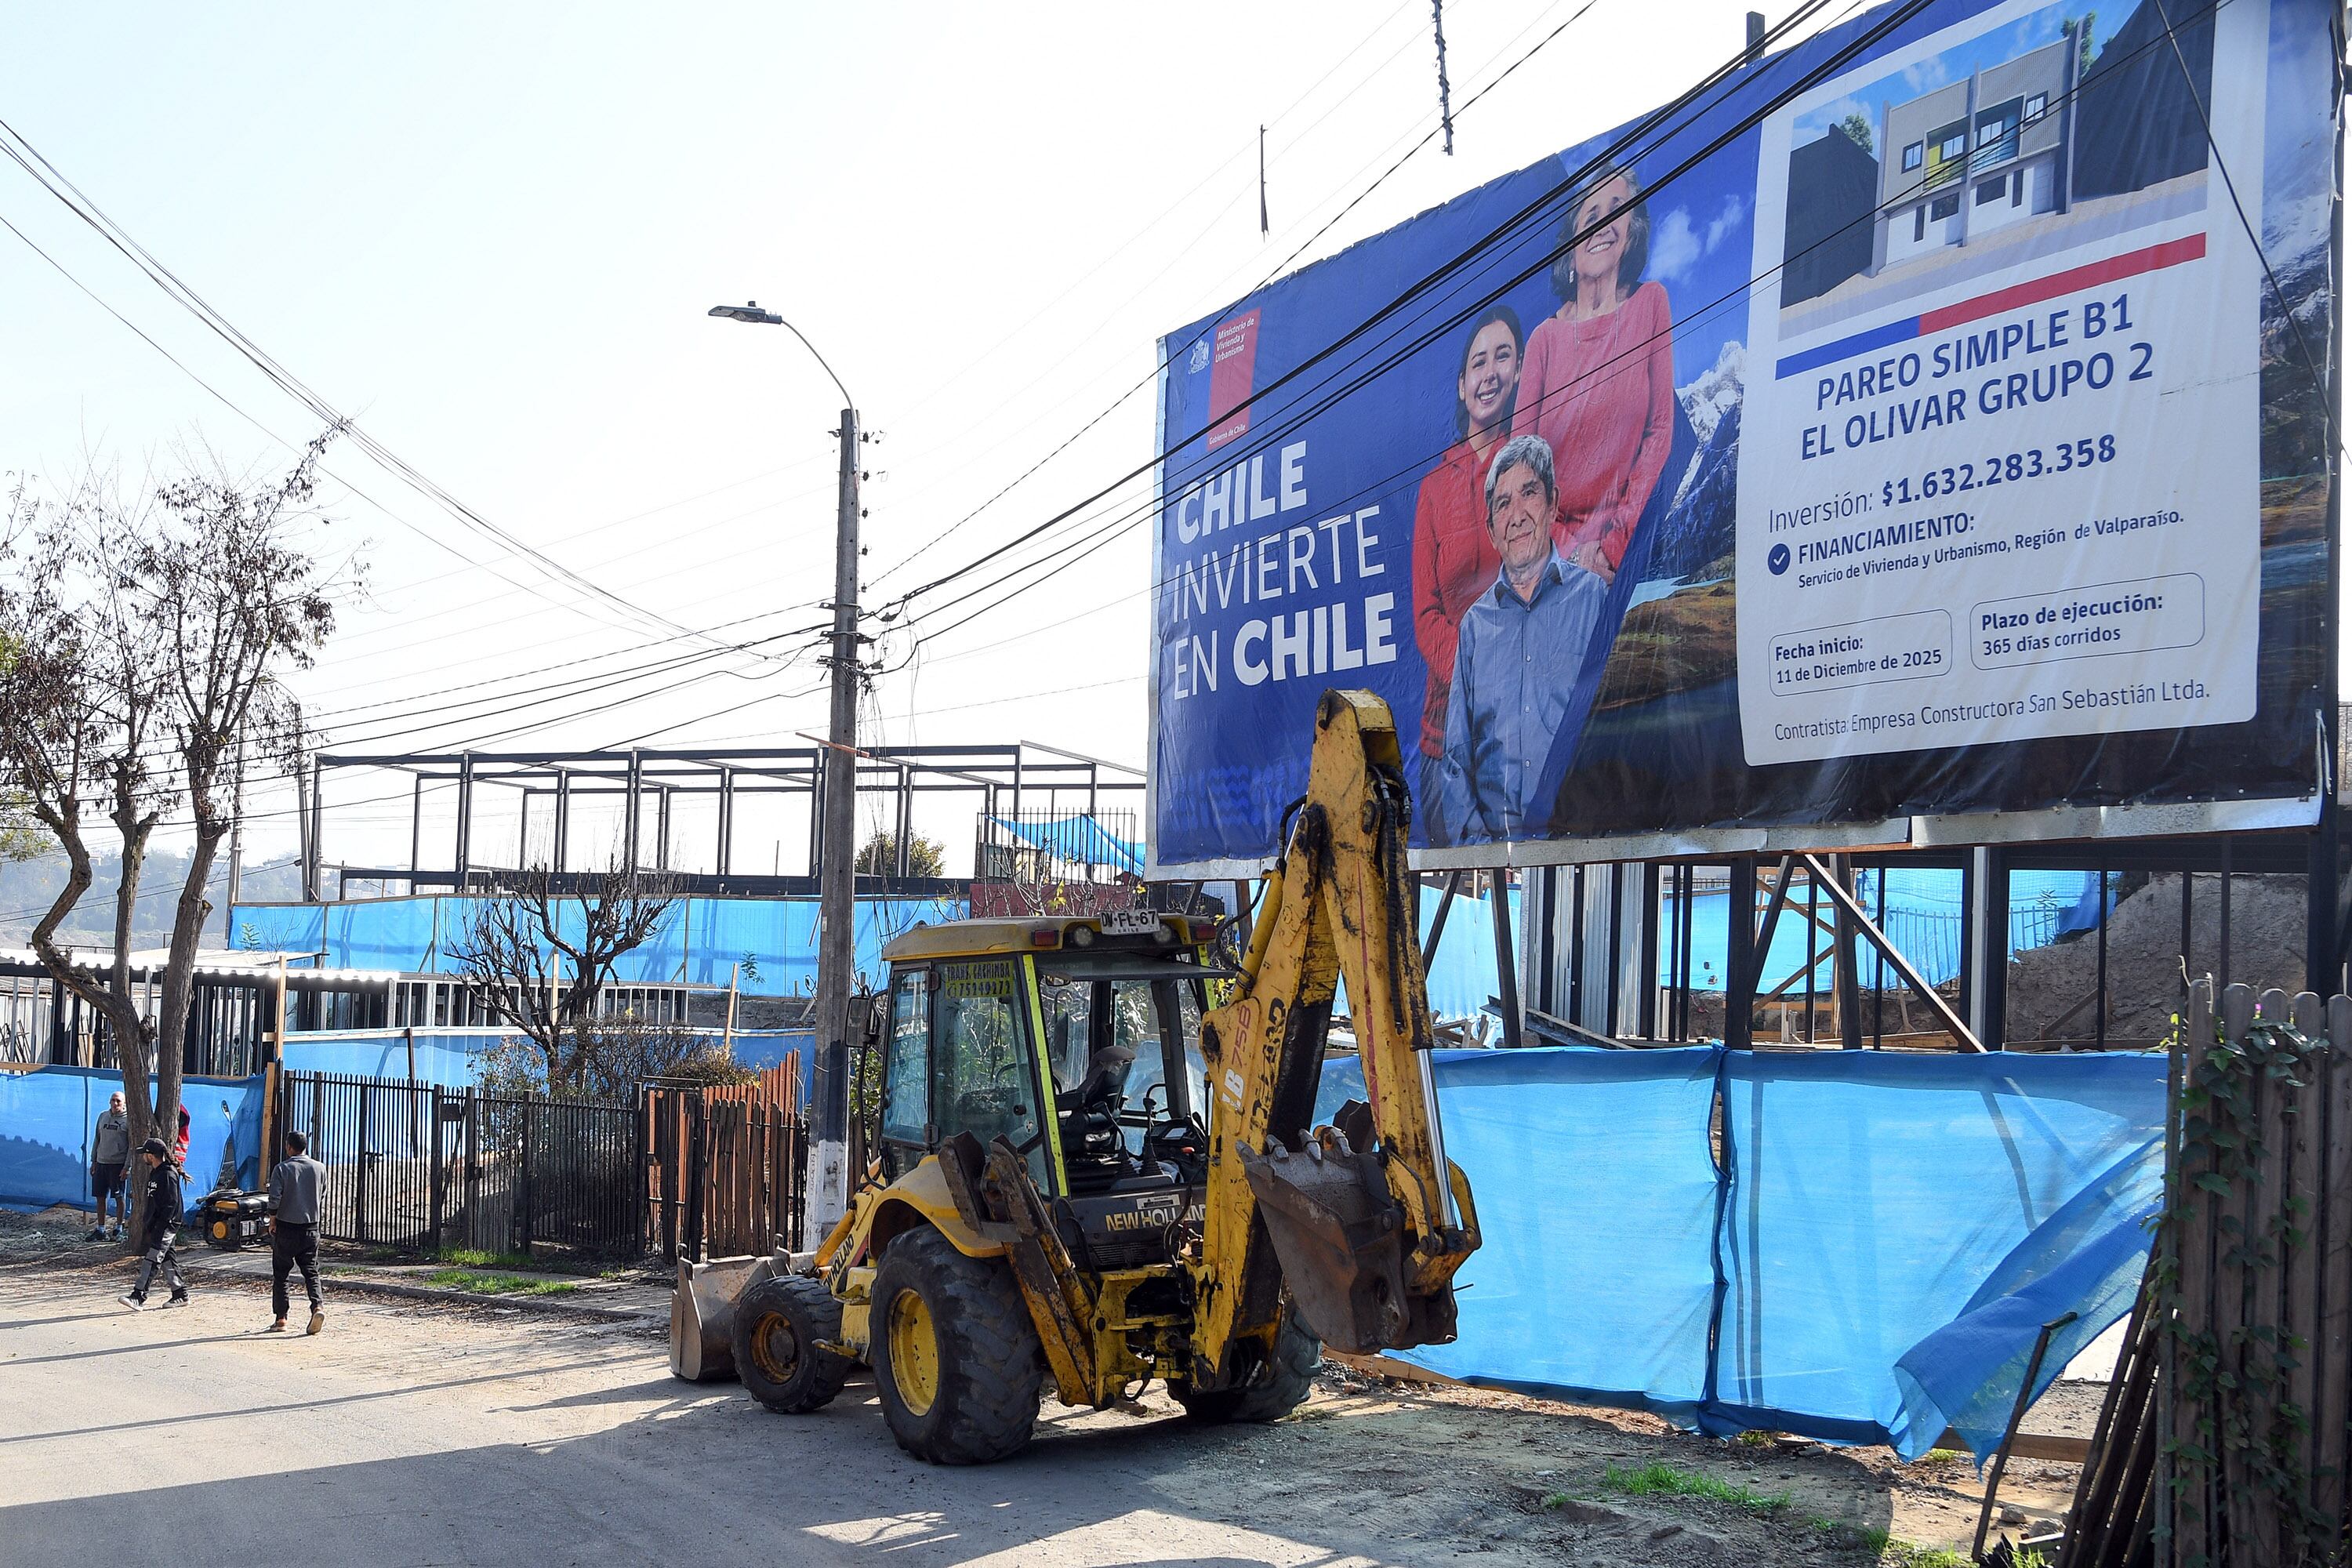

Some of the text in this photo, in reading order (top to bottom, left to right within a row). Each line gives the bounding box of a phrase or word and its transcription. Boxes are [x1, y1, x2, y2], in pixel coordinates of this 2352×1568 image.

[1215, 344, 1244, 363] Urbanismo
[1217, 333, 1245, 351] Vivienda y
[1218, 318, 1254, 340] Ministerio de
[1817, 294, 2132, 411] PAREO SIMPLE B1
[1802, 343, 2153, 460] EL OLIVAR GRUPO 2
[1178, 440, 1307, 544] CHILE
[1769, 434, 2116, 533] Inversión: $1.632.283.358
[1174, 505, 1385, 623] INVIERTE
[1798, 513, 1975, 564] FINANCIAMIENTO:
[1798, 510, 2184, 588] Servicio de Vivienda y Urbanismo, Región de Valparaíso.
[1982, 593, 2163, 631] Plazo de ejecución:
[1174, 592, 1396, 700] EN CHILE
[1775, 635, 1864, 661] Fecha inicio:
[1777, 649, 1942, 684] 11 de Diciembre de 2025
[1983, 626, 2121, 655] 365 días corridos
[1775, 679, 2210, 741] Contratista: Empresa Constructora San Sebastián Ltda.
